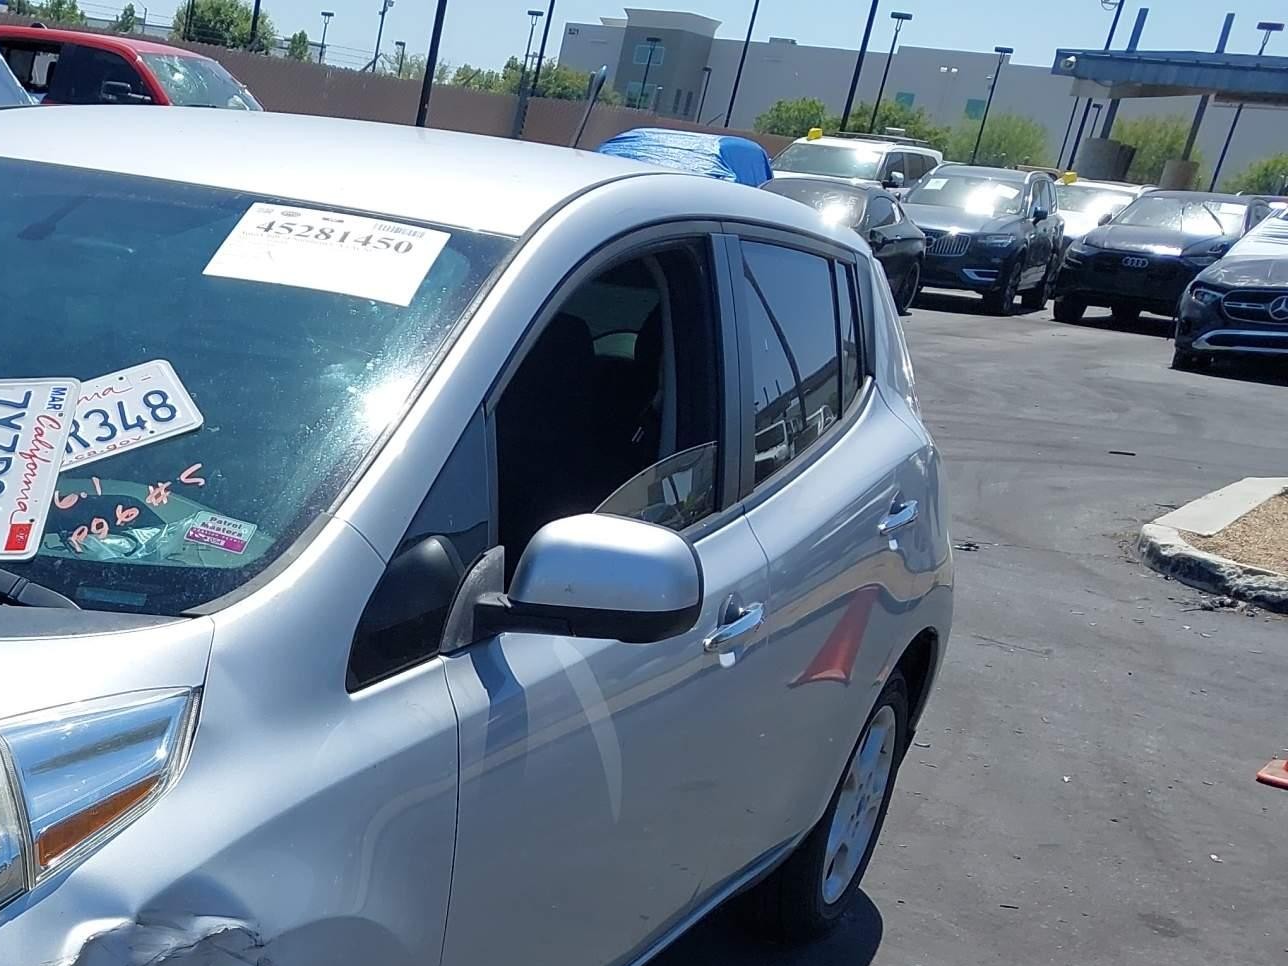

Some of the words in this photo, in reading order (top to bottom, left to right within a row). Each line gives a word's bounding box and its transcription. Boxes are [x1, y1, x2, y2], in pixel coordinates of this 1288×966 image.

[255, 220, 414, 255] 45281450
[46, 387, 68, 410] MAR
[10, 414, 62, 525] California
[209, 516, 243, 530] Patrol
